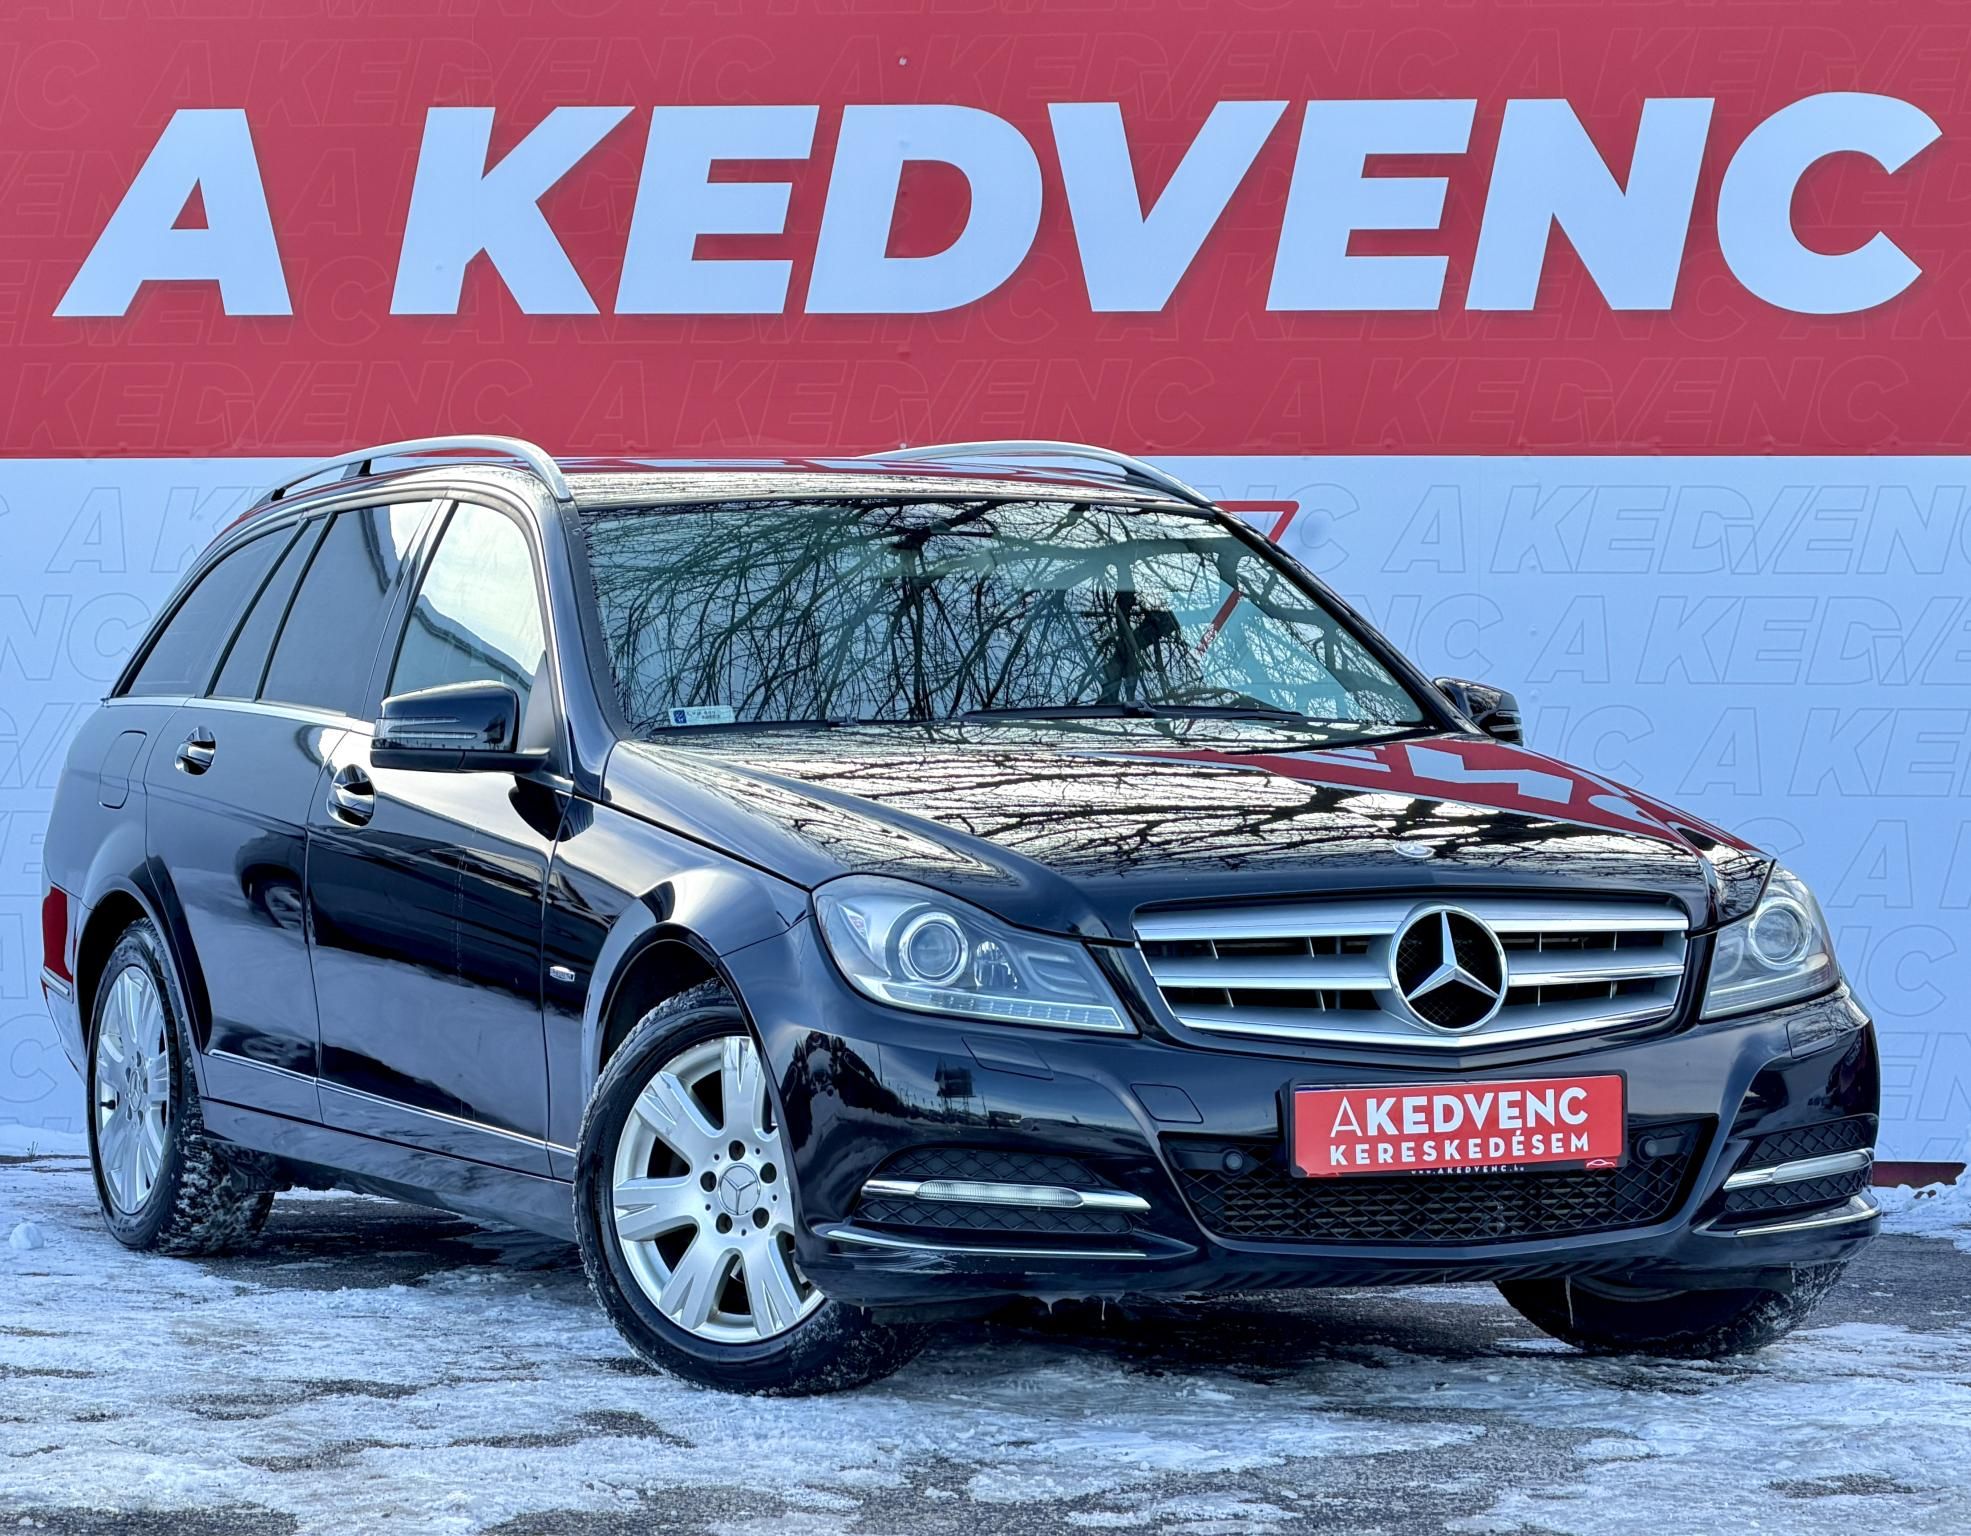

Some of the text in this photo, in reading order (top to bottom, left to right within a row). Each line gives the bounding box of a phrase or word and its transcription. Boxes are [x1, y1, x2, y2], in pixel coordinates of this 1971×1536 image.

[54, 107, 294, 318] A
[389, 91, 1943, 315] KEDVENC
[565, 359, 649, 448] A
[672, 356, 1216, 448] KEDVENC
[1240, 356, 1328, 447] A
[1352, 354, 1909, 448] KEDVENC
[44, 486, 128, 575] A
[1381, 484, 1465, 574] A
[1489, 484, 1971, 575] KEDVEN
[1524, 595, 1611, 684] A
[1675, 707, 1763, 797] A
[1826, 819, 1913, 910] A
[1330, 1130, 1590, 1167] KERESKEDÉSEM
